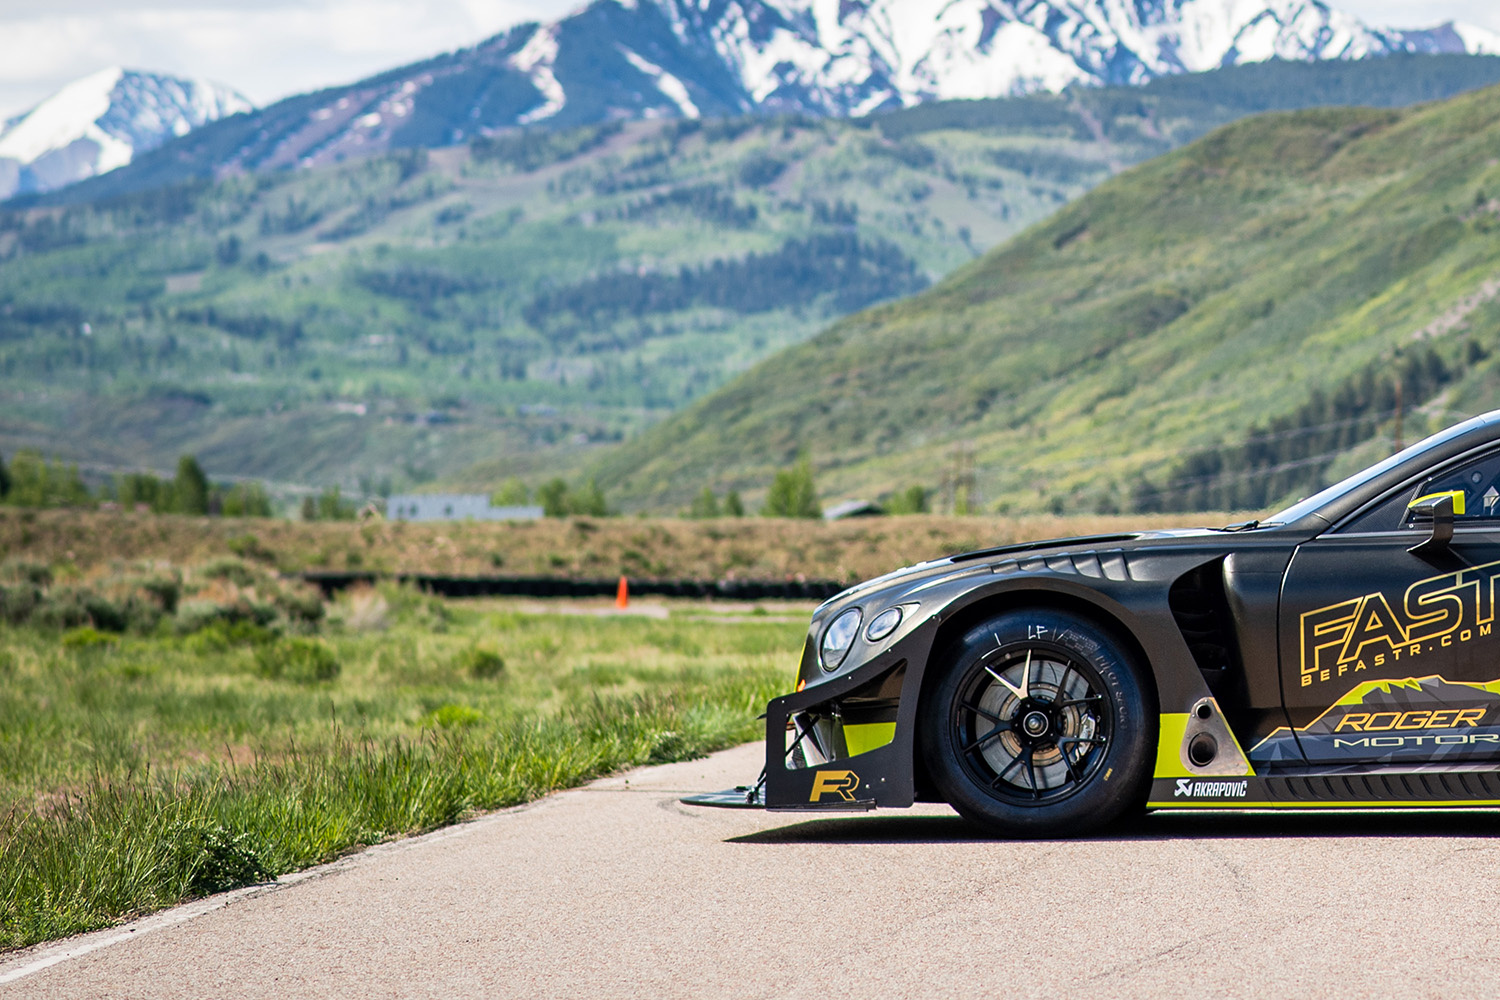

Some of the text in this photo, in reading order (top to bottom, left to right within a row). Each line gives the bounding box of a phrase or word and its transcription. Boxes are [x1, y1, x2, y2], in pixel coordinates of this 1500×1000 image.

[1028, 625, 1048, 640] LF
[1301, 624, 1492, 687] BEFASTR.COM
[1334, 708, 1487, 732] ROGER
